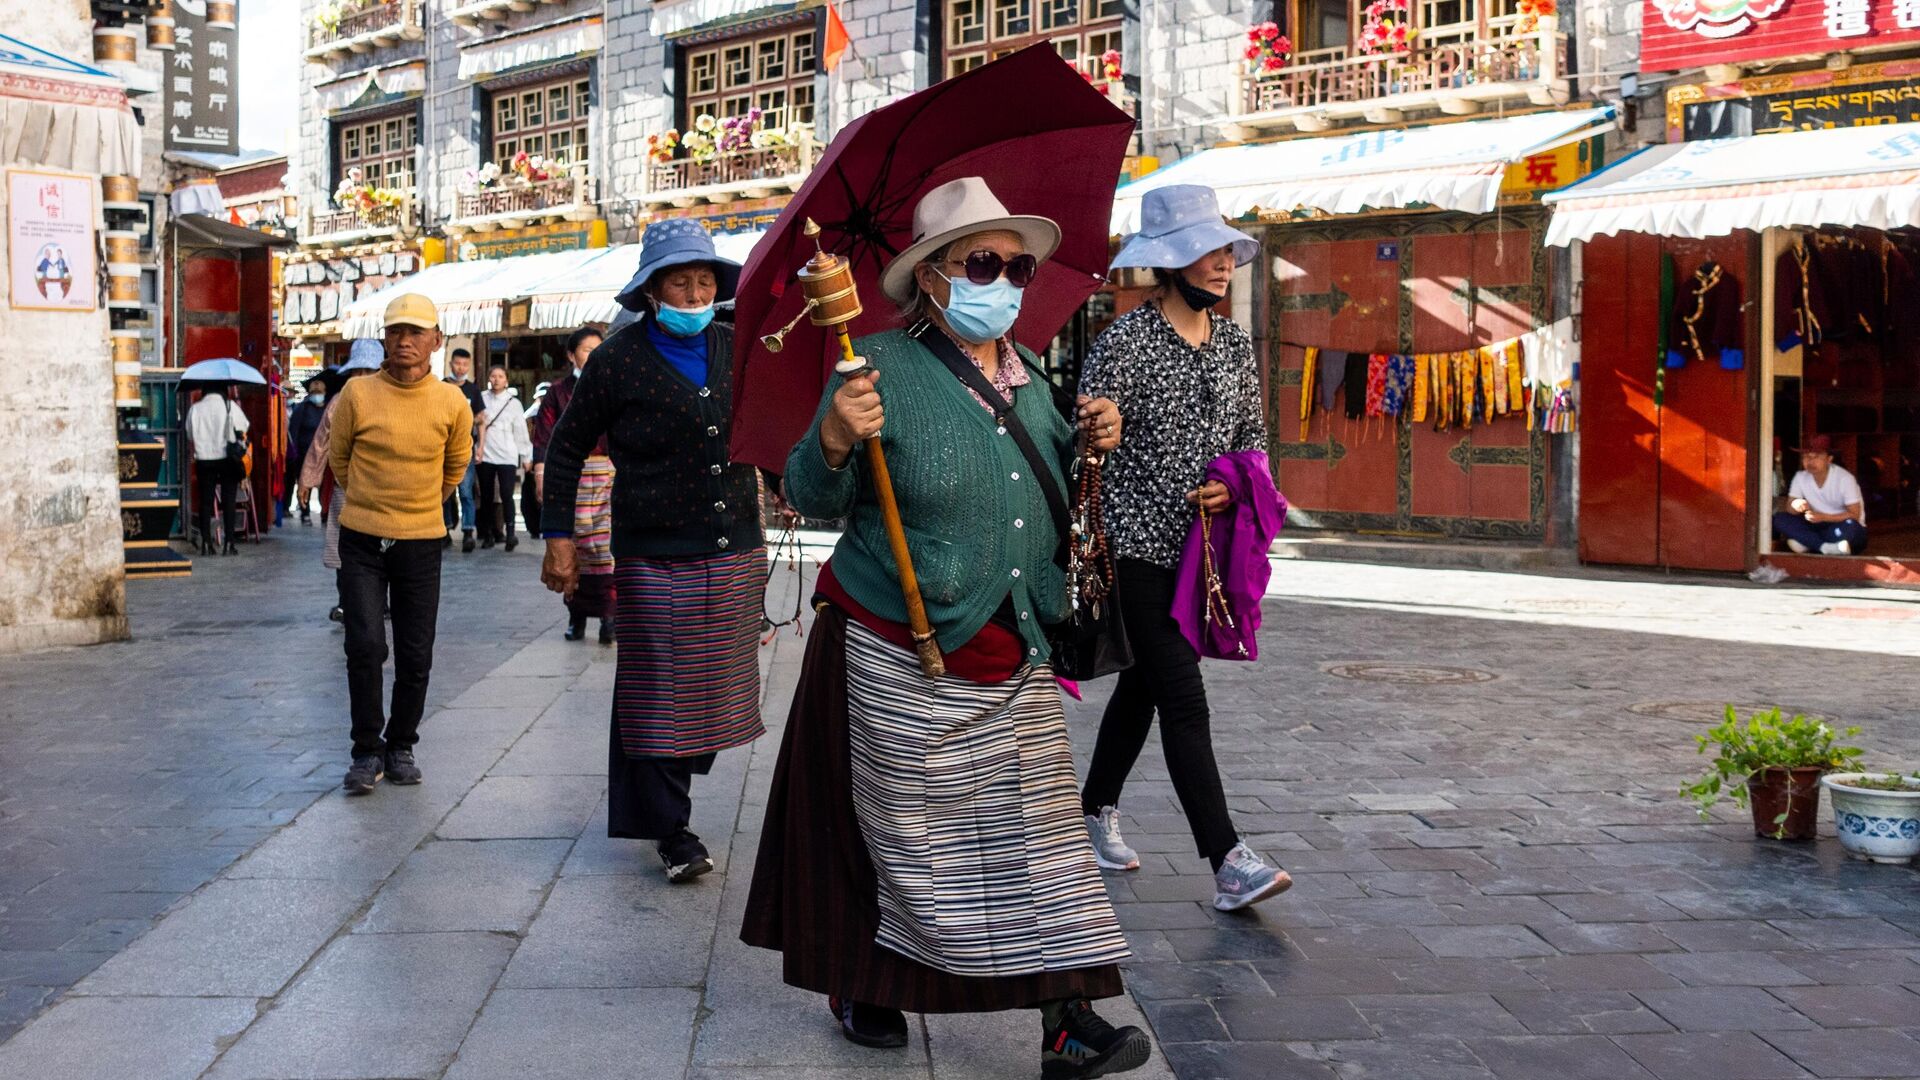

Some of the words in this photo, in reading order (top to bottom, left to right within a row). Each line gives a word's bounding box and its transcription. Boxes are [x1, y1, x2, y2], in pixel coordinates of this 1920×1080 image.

[173, 26, 193, 120] 艺术画廊
[208, 40, 228, 112] 咖啡厅
[1525, 154, 1558, 187] 玩
